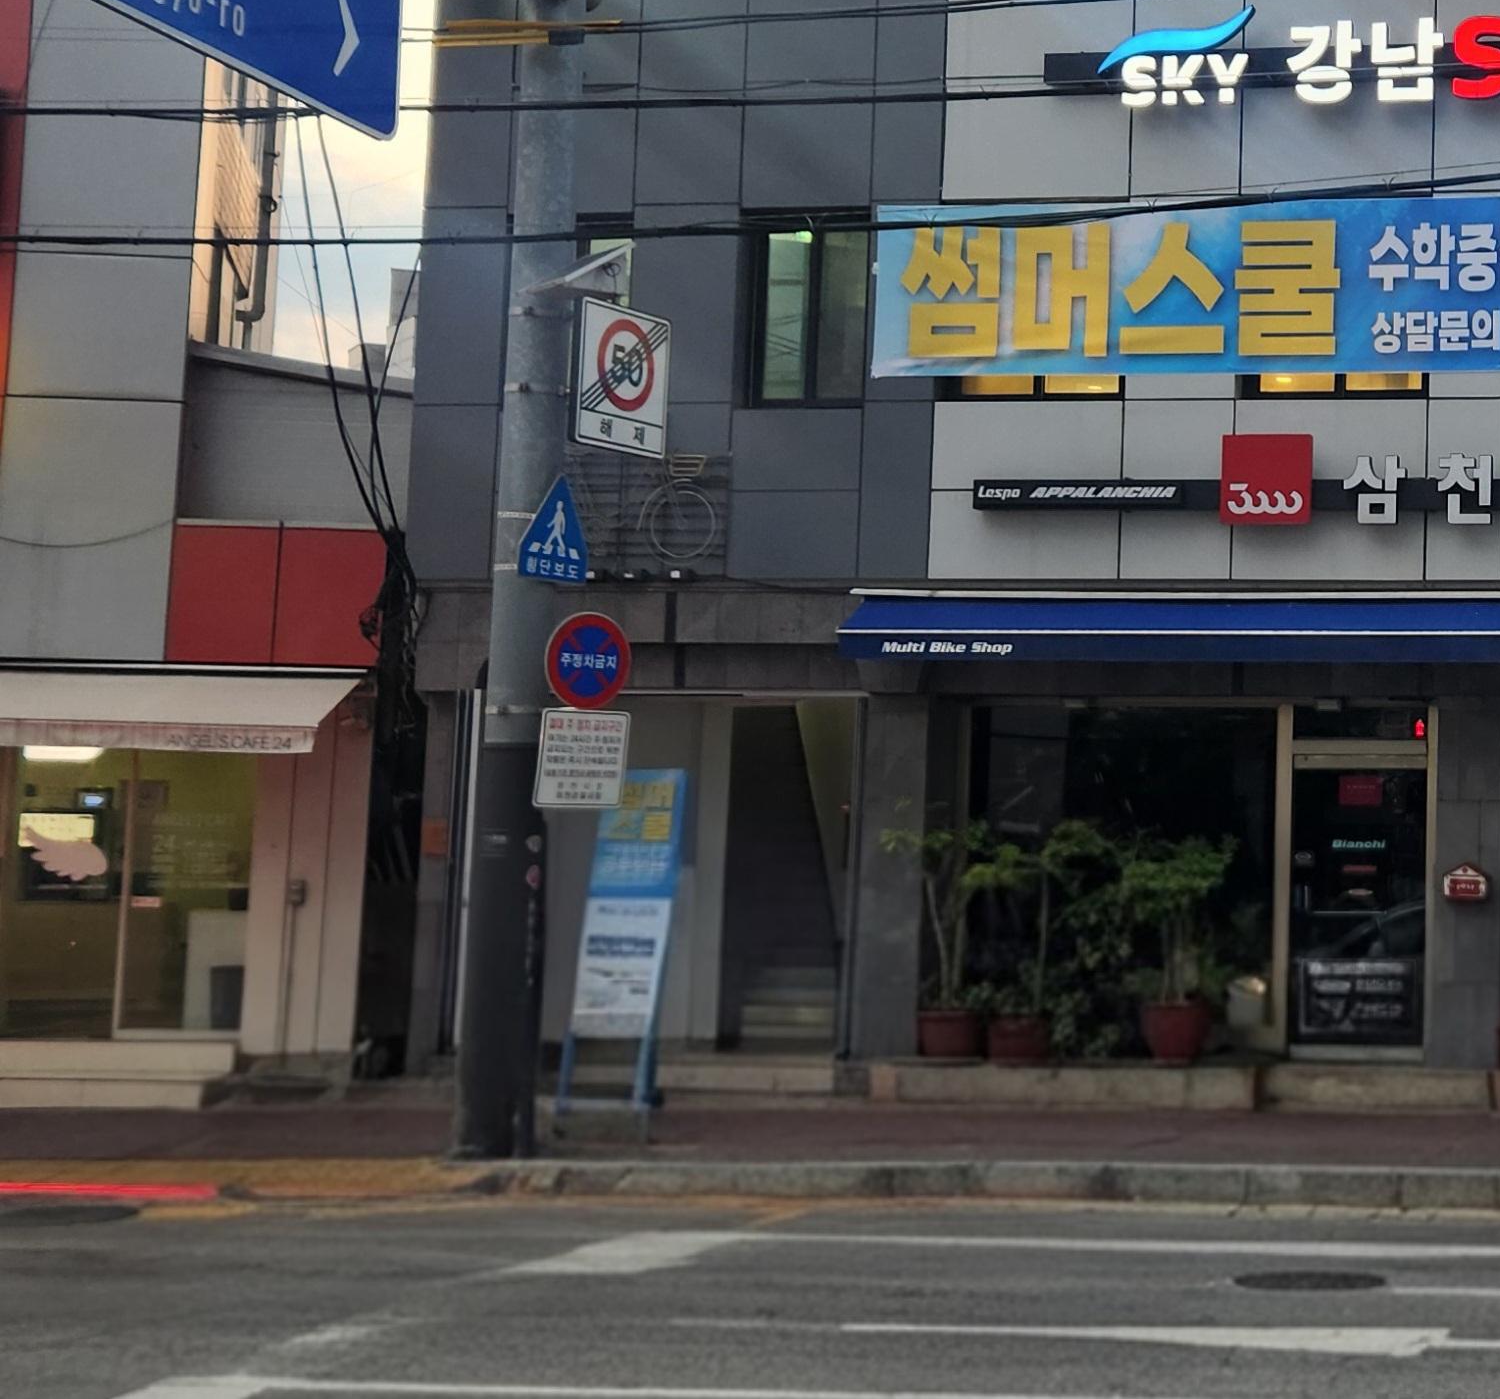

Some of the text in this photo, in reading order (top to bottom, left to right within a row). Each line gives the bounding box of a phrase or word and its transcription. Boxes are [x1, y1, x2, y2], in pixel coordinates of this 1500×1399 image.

[1120, 53, 1249, 108] SKY
[900, 218, 1342, 358] 썸머스쿨
[611, 343, 645, 388] 50
[881, 641, 1014, 656] Multi Bike Shop
[1331, 838, 1387, 850] Bianchi
